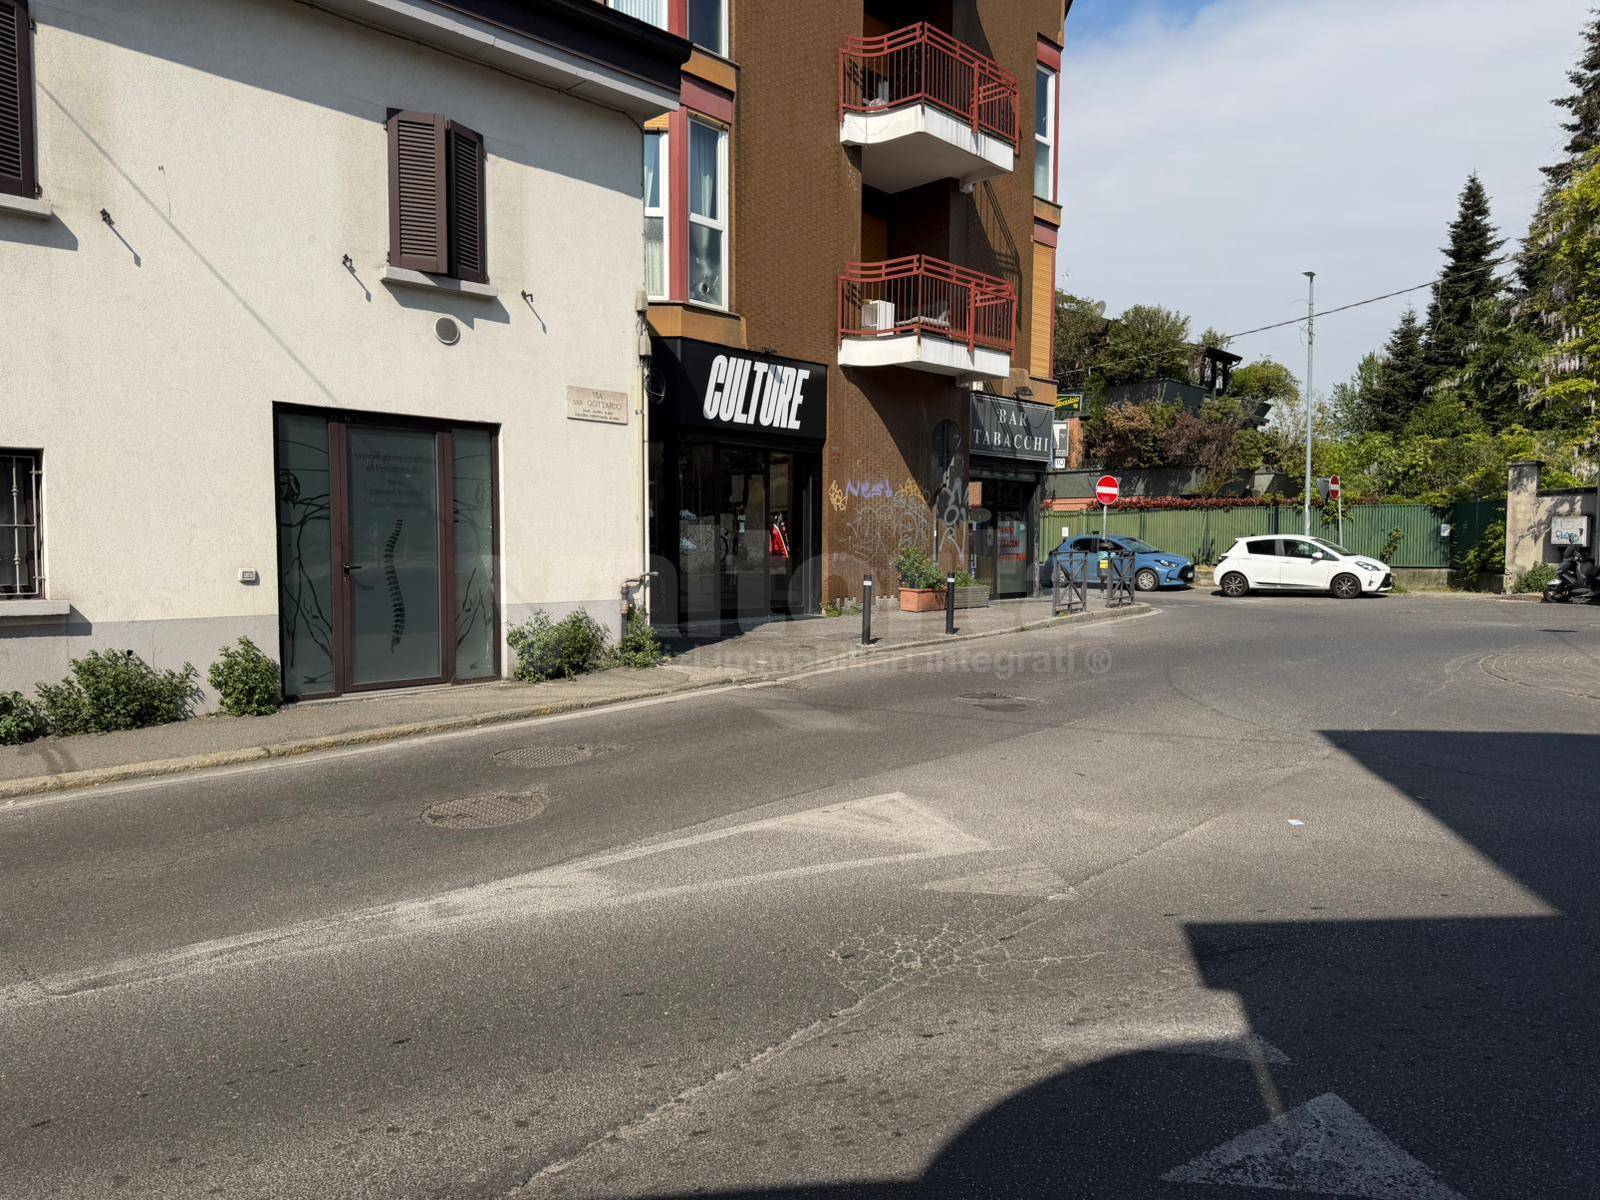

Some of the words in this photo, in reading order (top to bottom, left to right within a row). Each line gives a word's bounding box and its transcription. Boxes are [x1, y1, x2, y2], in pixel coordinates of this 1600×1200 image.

[592, 391, 604, 400] VIA
[703, 354, 811, 430] CULTURE
[997, 408, 1027, 426] BAR
[973, 428, 1049, 452] TABACCHI
